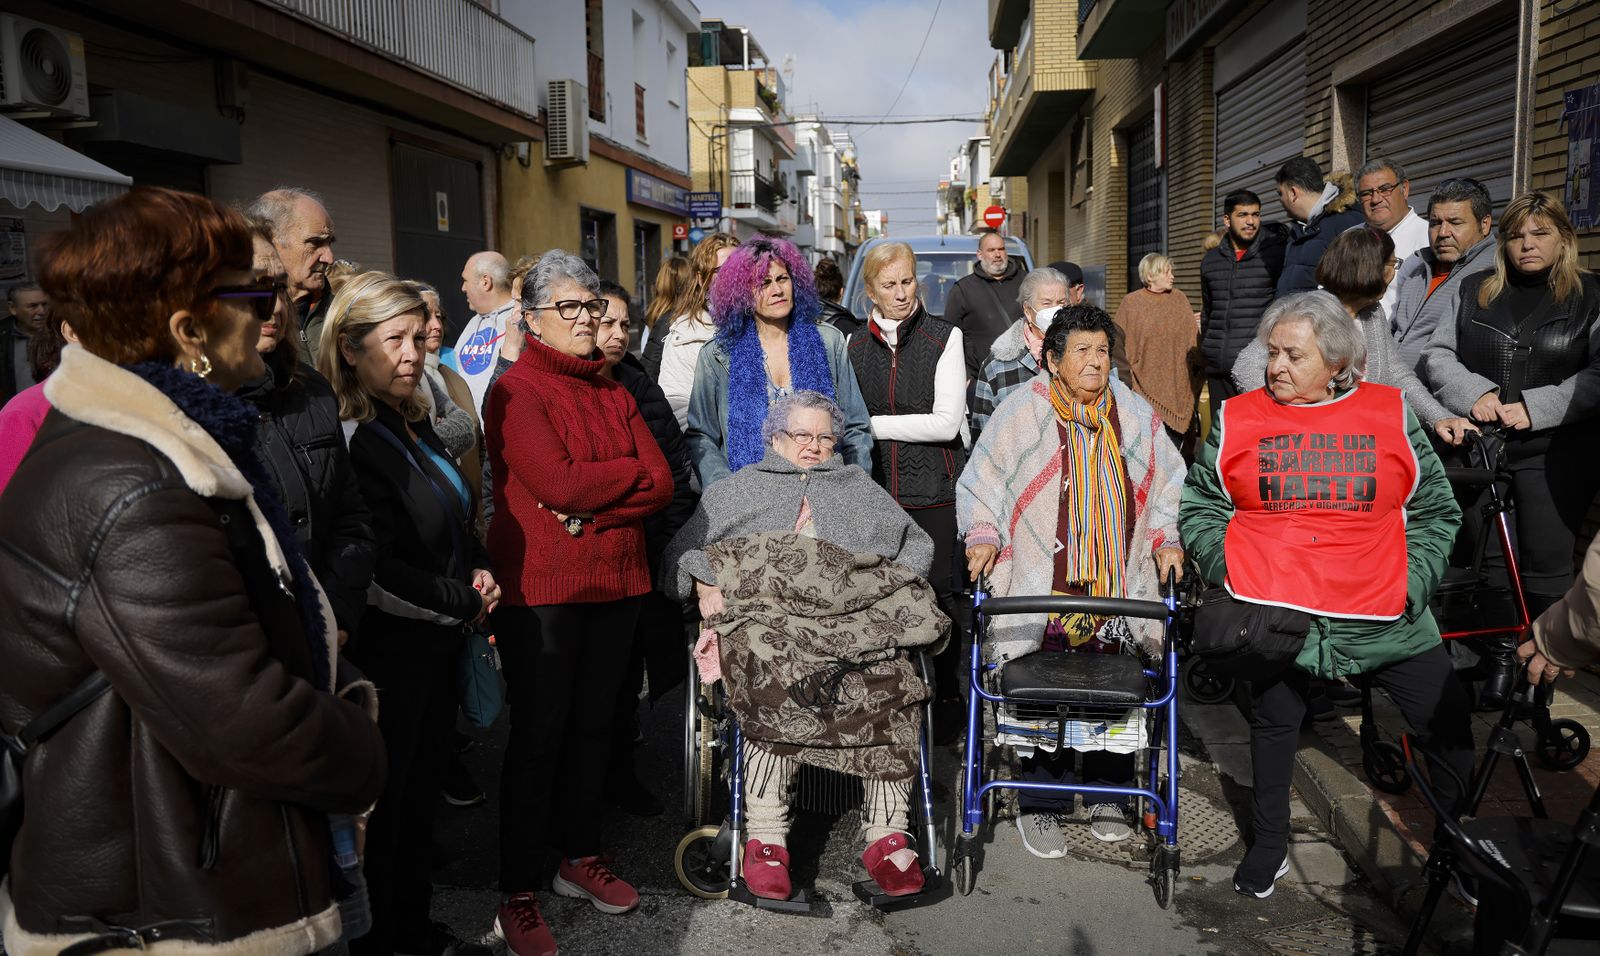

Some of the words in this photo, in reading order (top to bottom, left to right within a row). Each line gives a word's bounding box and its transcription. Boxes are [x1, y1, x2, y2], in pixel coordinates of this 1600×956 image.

[462, 344, 492, 355] NASA
[1259, 433, 1305, 450] SOY
[1310, 434, 1338, 450] DE
[1343, 434, 1376, 450] UN
[1259, 451, 1376, 473] BARRIO
[1259, 475, 1376, 501] HARTO
[1316, 501, 1359, 511] DIGNIDAD
[1361, 503, 1373, 512] YA!
